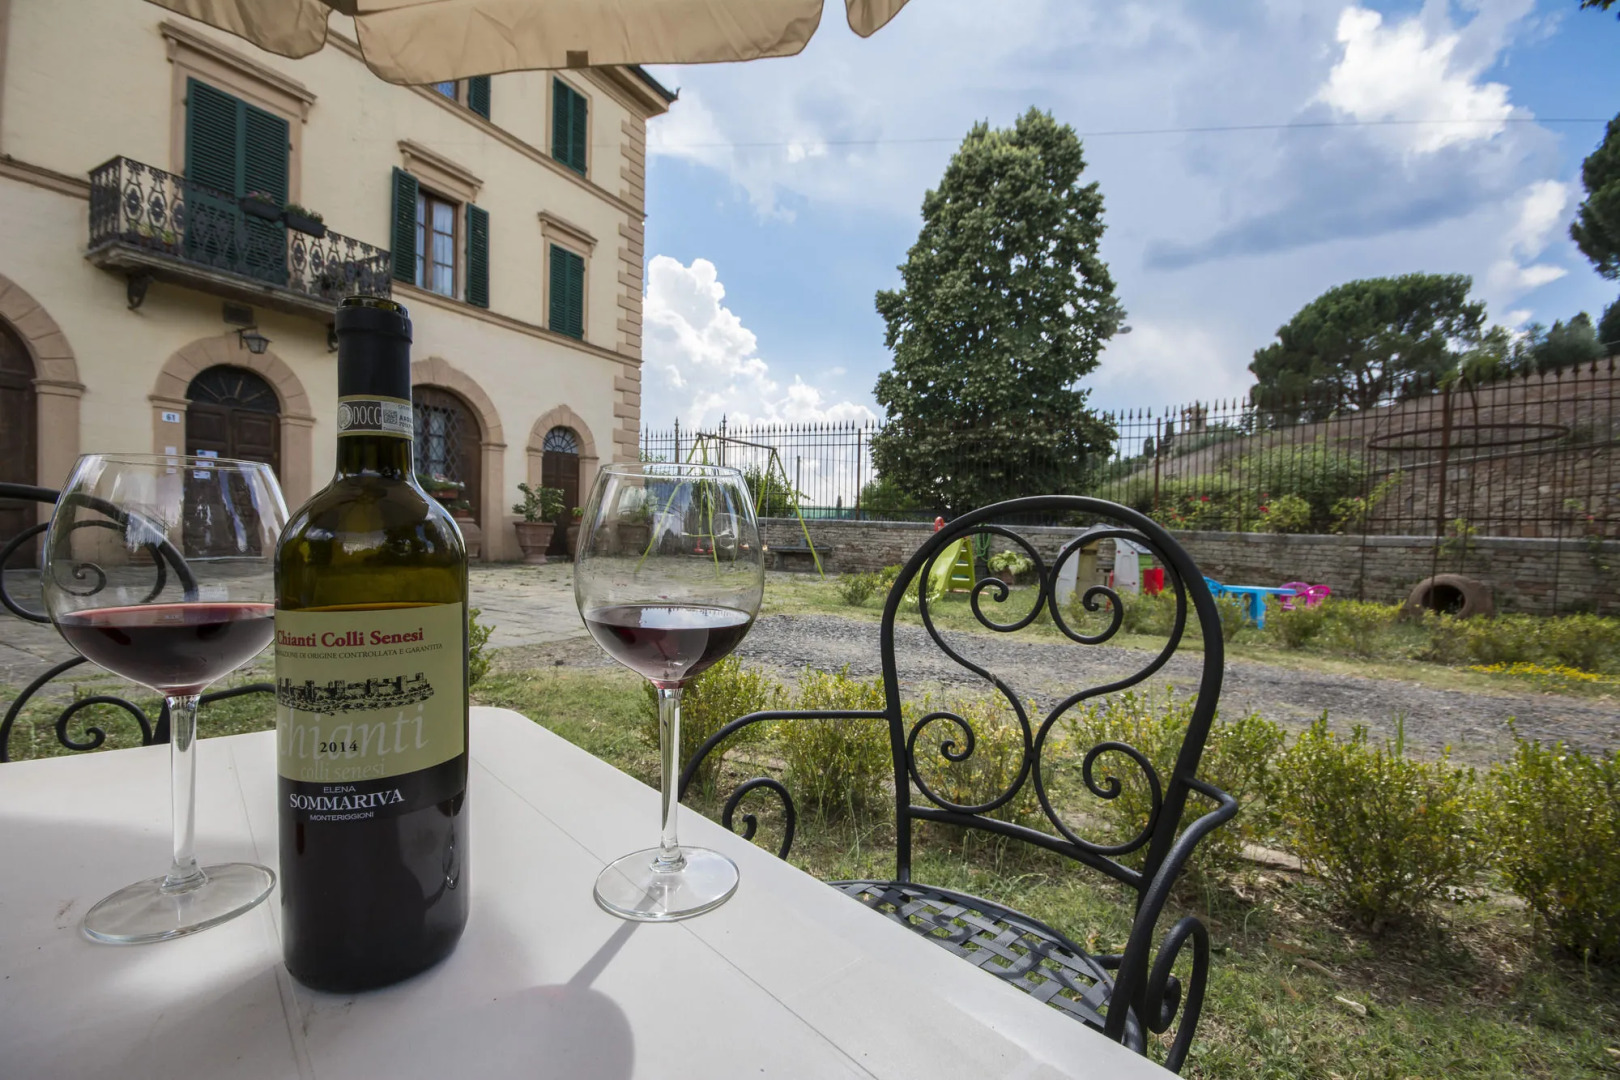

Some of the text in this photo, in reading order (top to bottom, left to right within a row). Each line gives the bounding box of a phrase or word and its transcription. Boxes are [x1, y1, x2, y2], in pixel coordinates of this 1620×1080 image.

[353, 405, 382, 425] DOCG
[277, 628, 425, 648] Chianti Colli Senesi
[338, 649, 398, 659] CONTROLLATA
[405, 643, 443, 654] GARANTITA
[278, 703, 430, 761] chianti
[319, 739, 359, 753] 2014
[300, 758, 386, 780] colli senesi
[289, 788, 405, 811] SOMMARIVA
[323, 785, 357, 794] ELENA
[309, 811, 375, 822] MONTERIGGIONI
